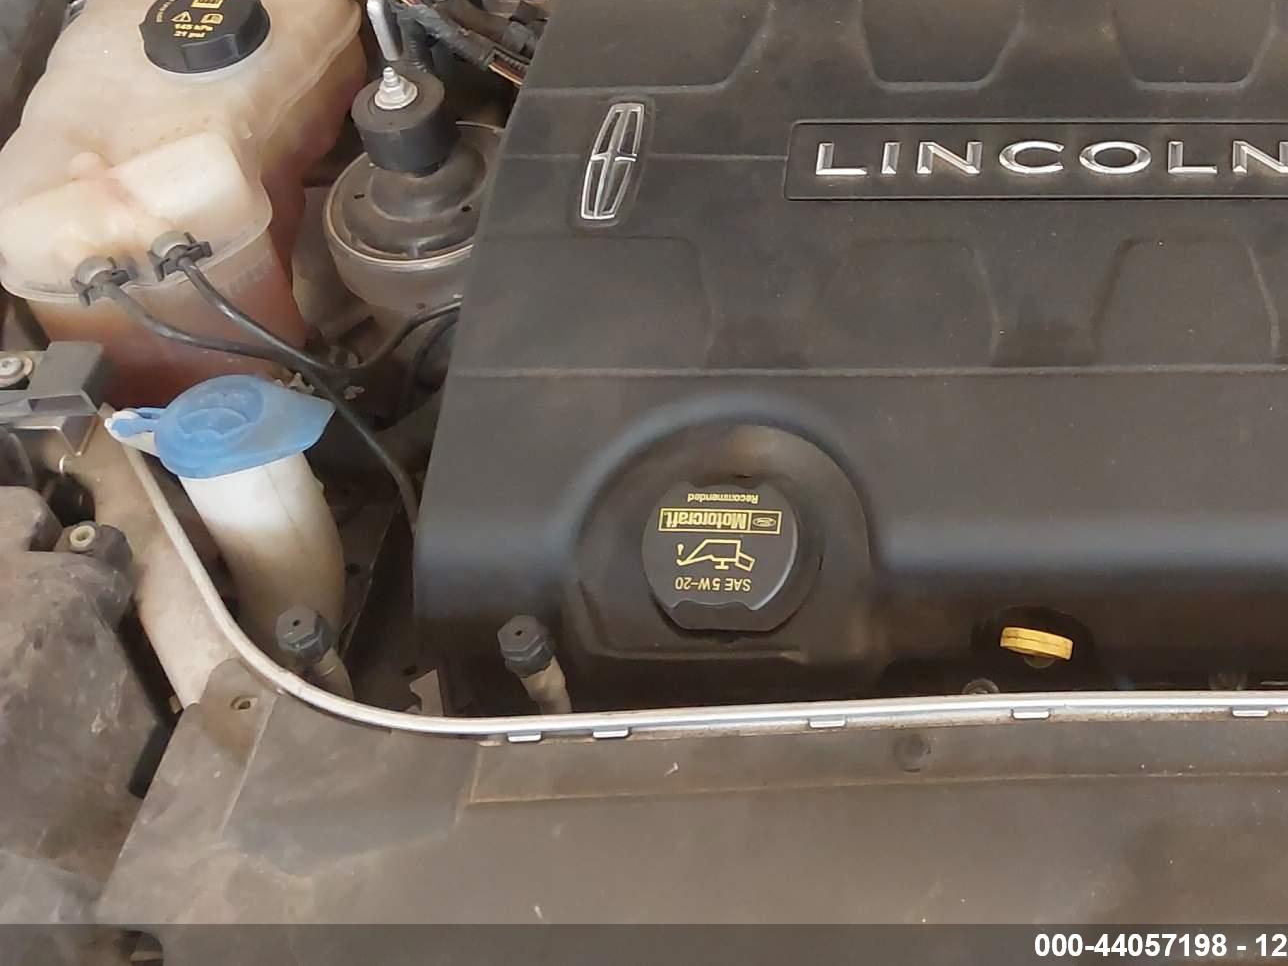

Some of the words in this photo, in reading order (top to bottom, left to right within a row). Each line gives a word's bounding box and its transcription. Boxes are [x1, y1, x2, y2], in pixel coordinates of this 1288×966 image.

[687, 493, 759, 504] Recommended
[666, 511, 747, 529] Motorcraft
[675, 576, 721, 591] 5W-20
[724, 578, 752, 592] SAE
